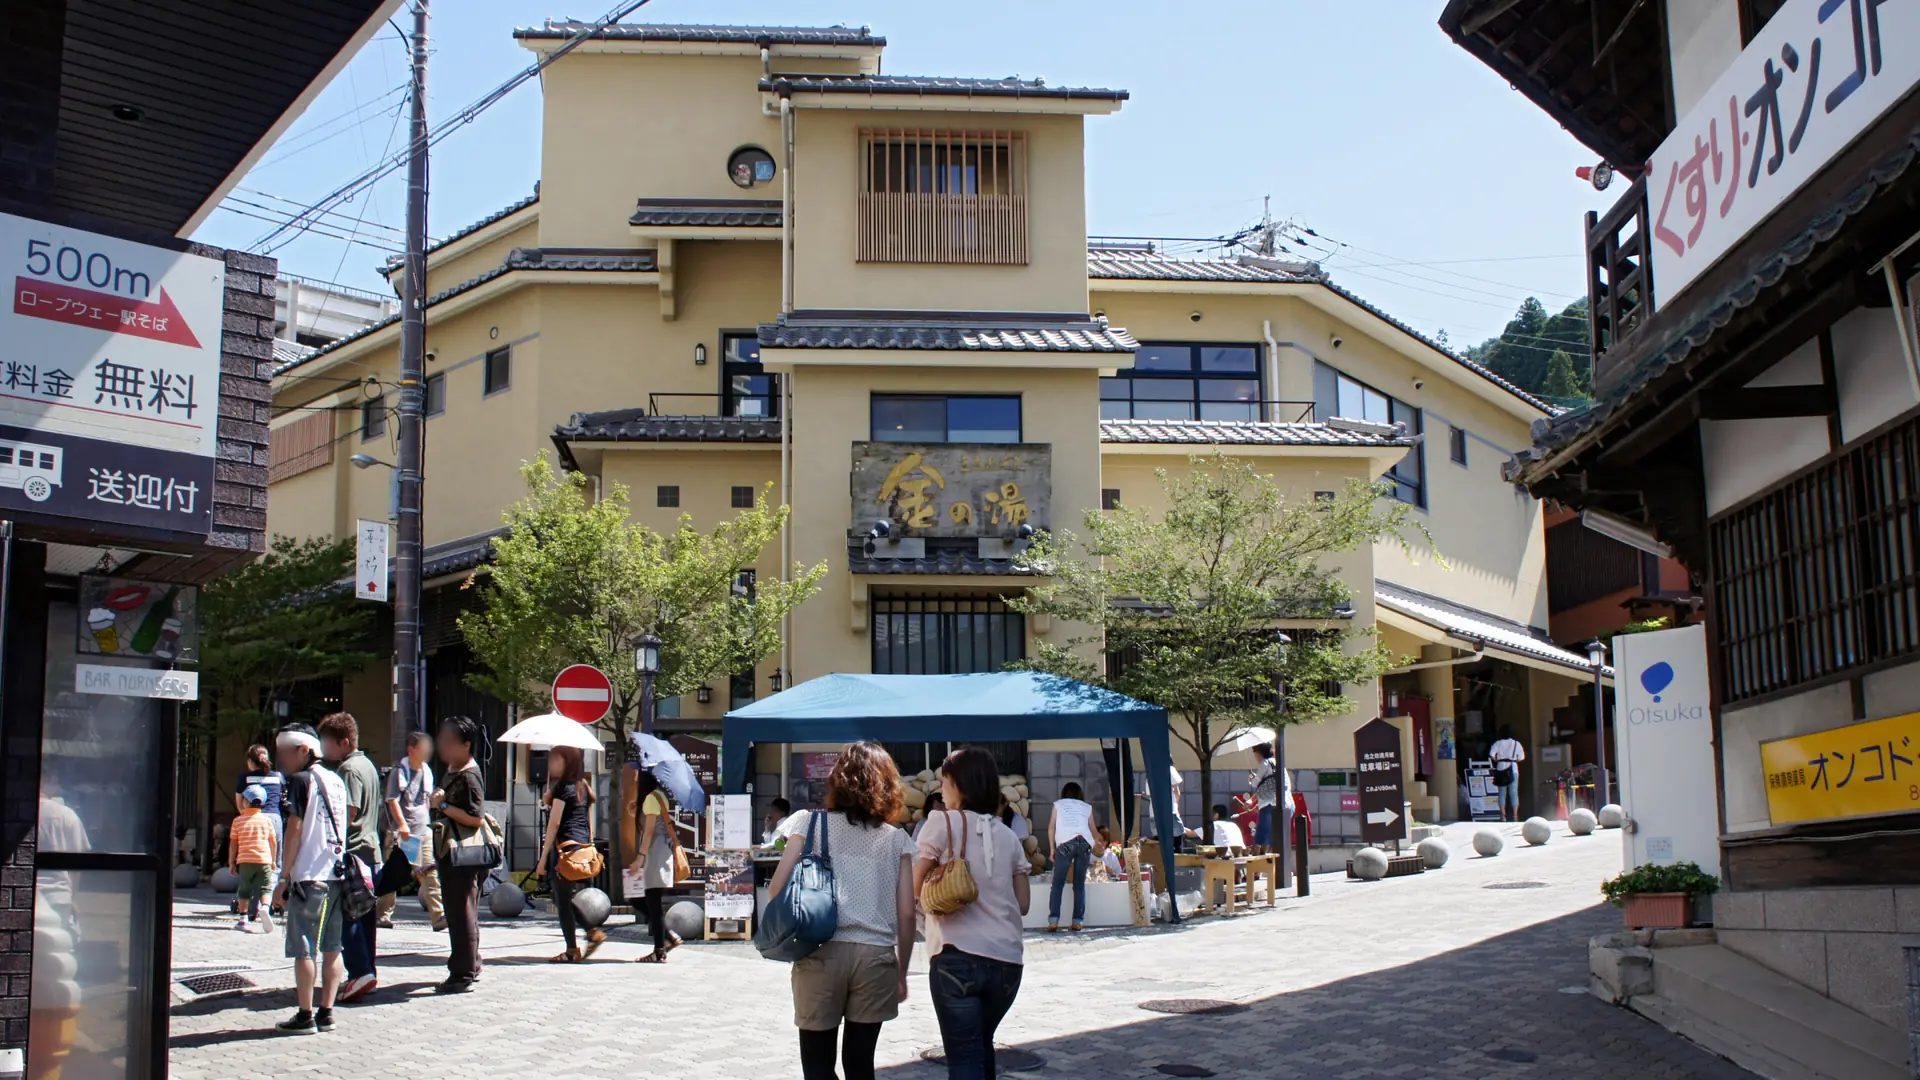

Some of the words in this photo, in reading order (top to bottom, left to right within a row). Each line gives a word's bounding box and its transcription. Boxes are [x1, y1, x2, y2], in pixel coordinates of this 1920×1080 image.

[26, 238, 150, 297] 500m
[20, 290, 169, 332] ロープウェー駅そば
[0, 360, 75, 400] 料金
[94, 358, 198, 420] 無料
[87, 467, 199, 514] 送迎付
[875, 451, 1030, 529] 金の湯
[84, 670, 112, 688] BAR
[1629, 703, 1703, 725] Otsuka
